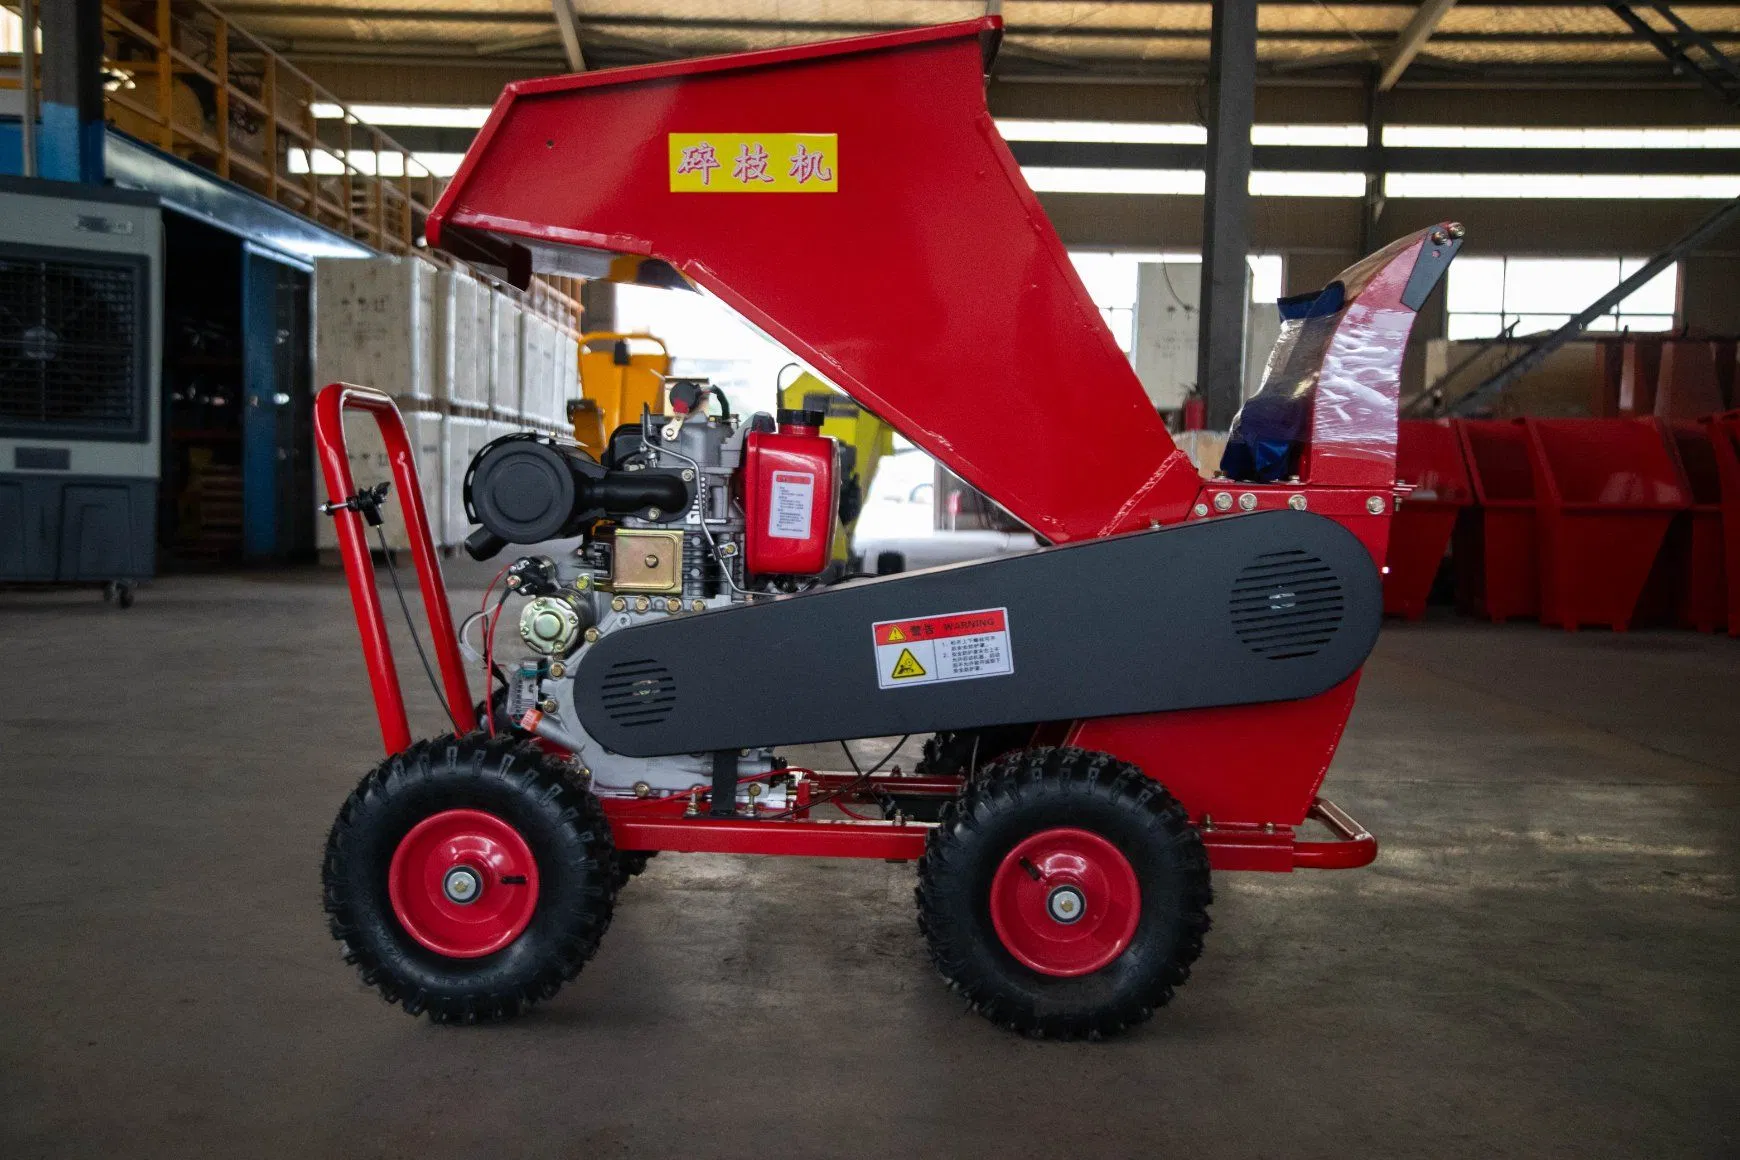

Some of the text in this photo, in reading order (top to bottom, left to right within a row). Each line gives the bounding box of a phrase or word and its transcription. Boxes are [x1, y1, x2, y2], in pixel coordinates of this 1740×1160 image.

[677, 143, 832, 185] 碎枝机
[910, 618, 995, 636] 警告 WARNING
